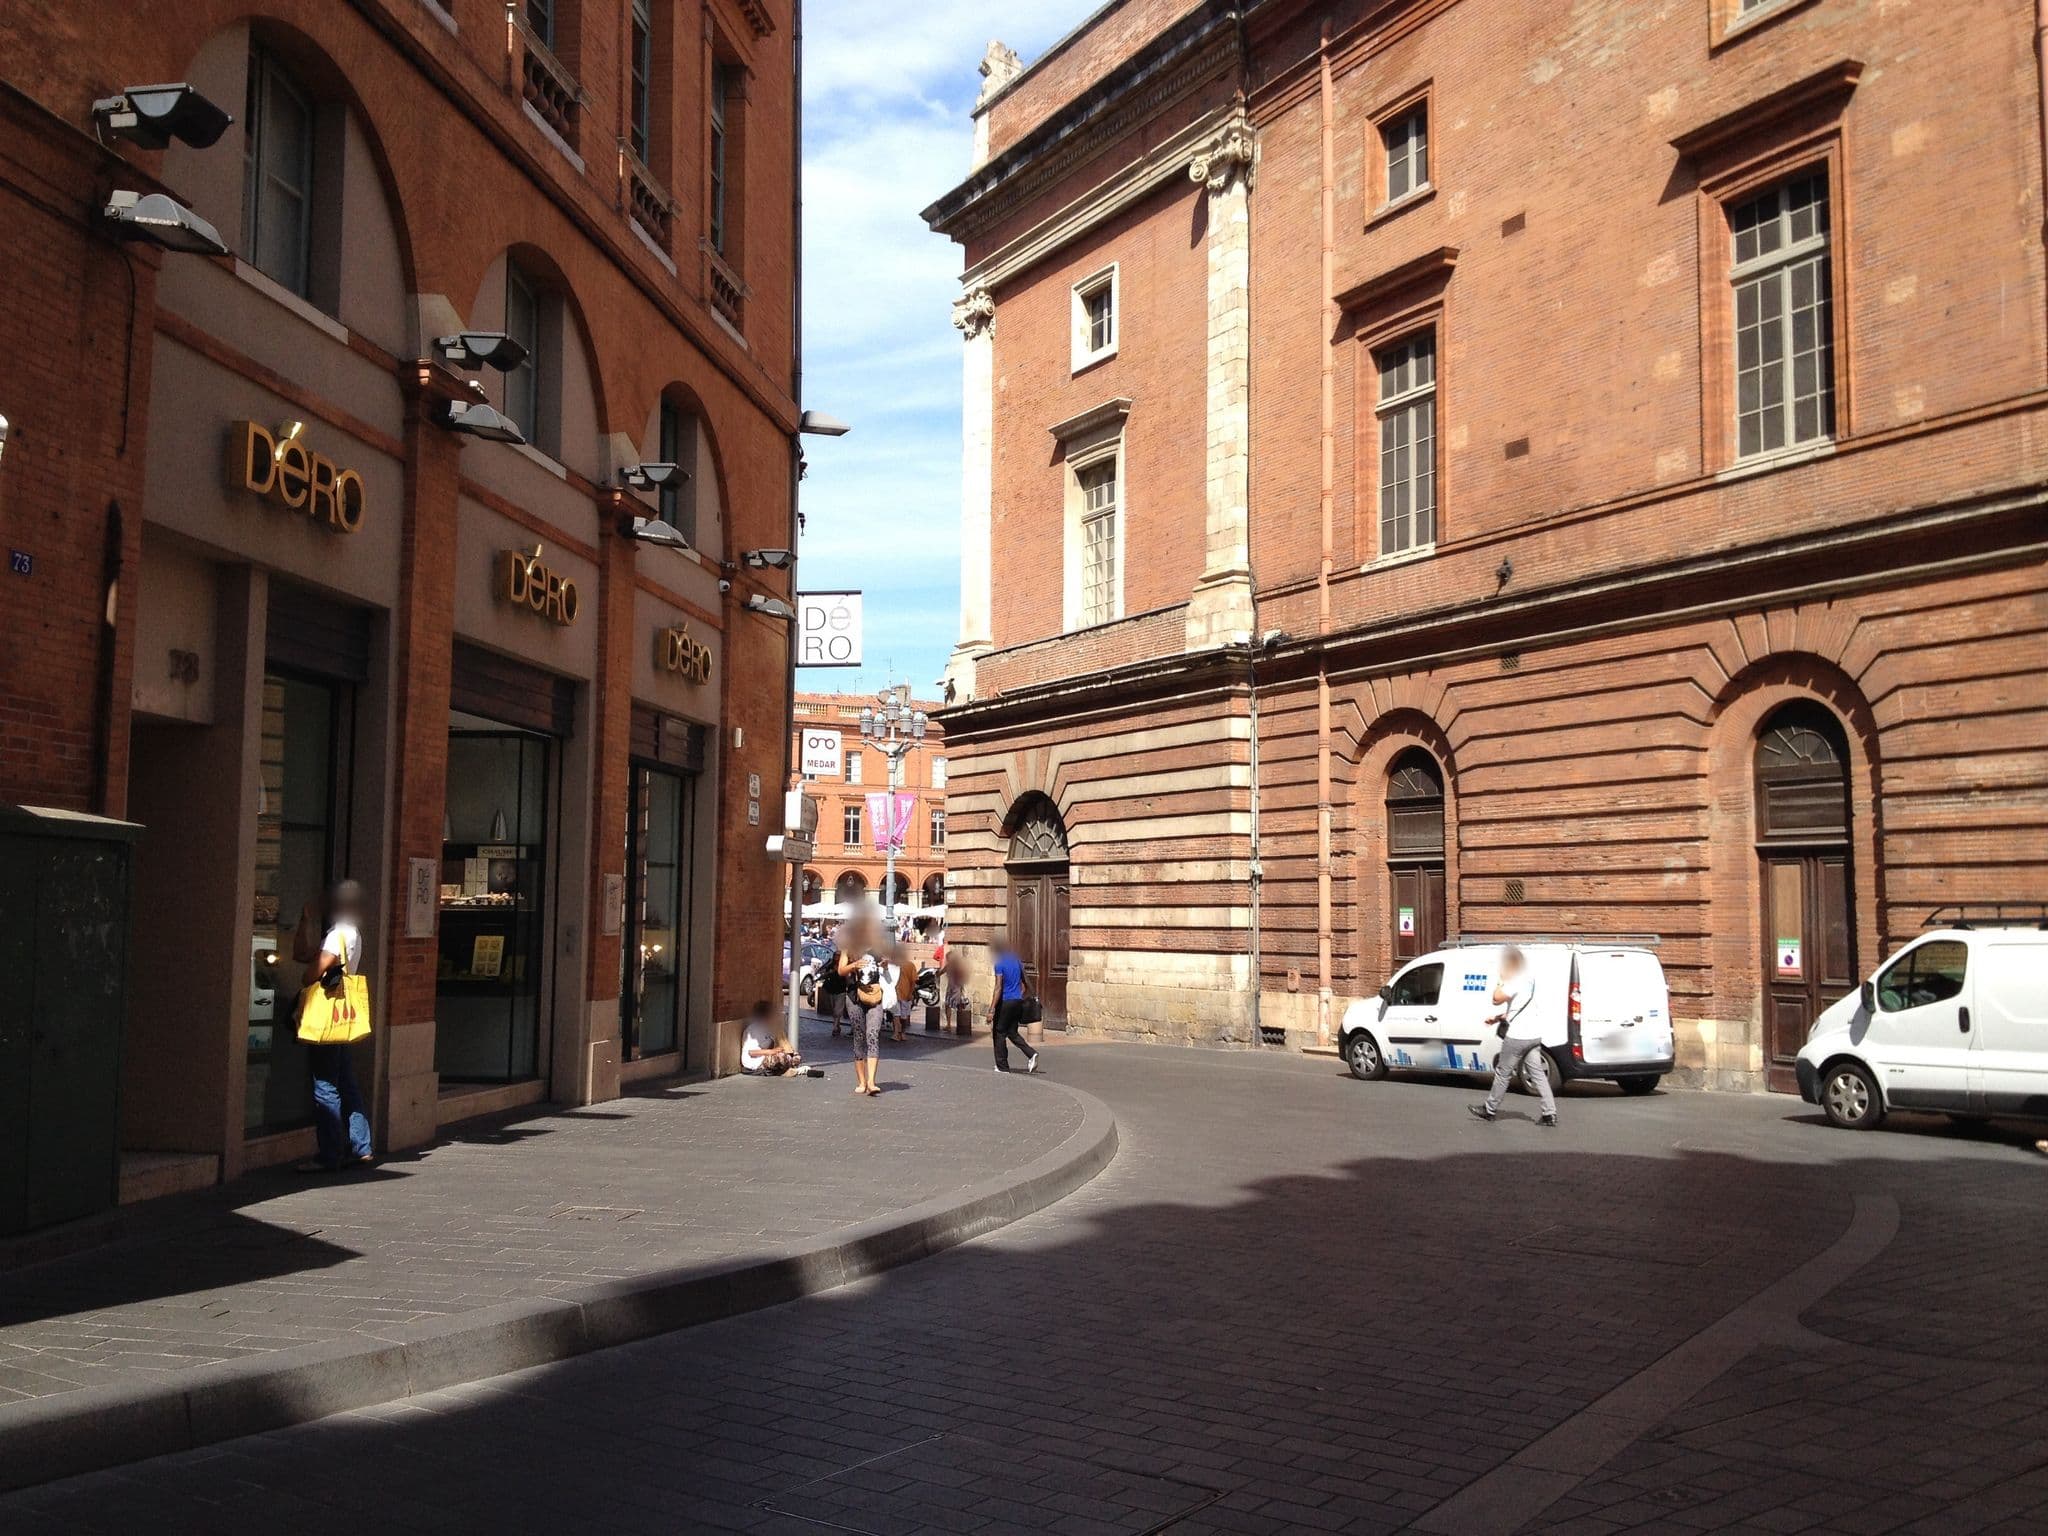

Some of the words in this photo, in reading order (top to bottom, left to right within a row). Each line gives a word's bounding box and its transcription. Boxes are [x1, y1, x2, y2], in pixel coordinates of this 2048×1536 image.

[13, 551, 31, 573] 73
[805, 597, 851, 631] Dé
[805, 635, 852, 660] RO
[807, 759, 836, 768] MEDAR
